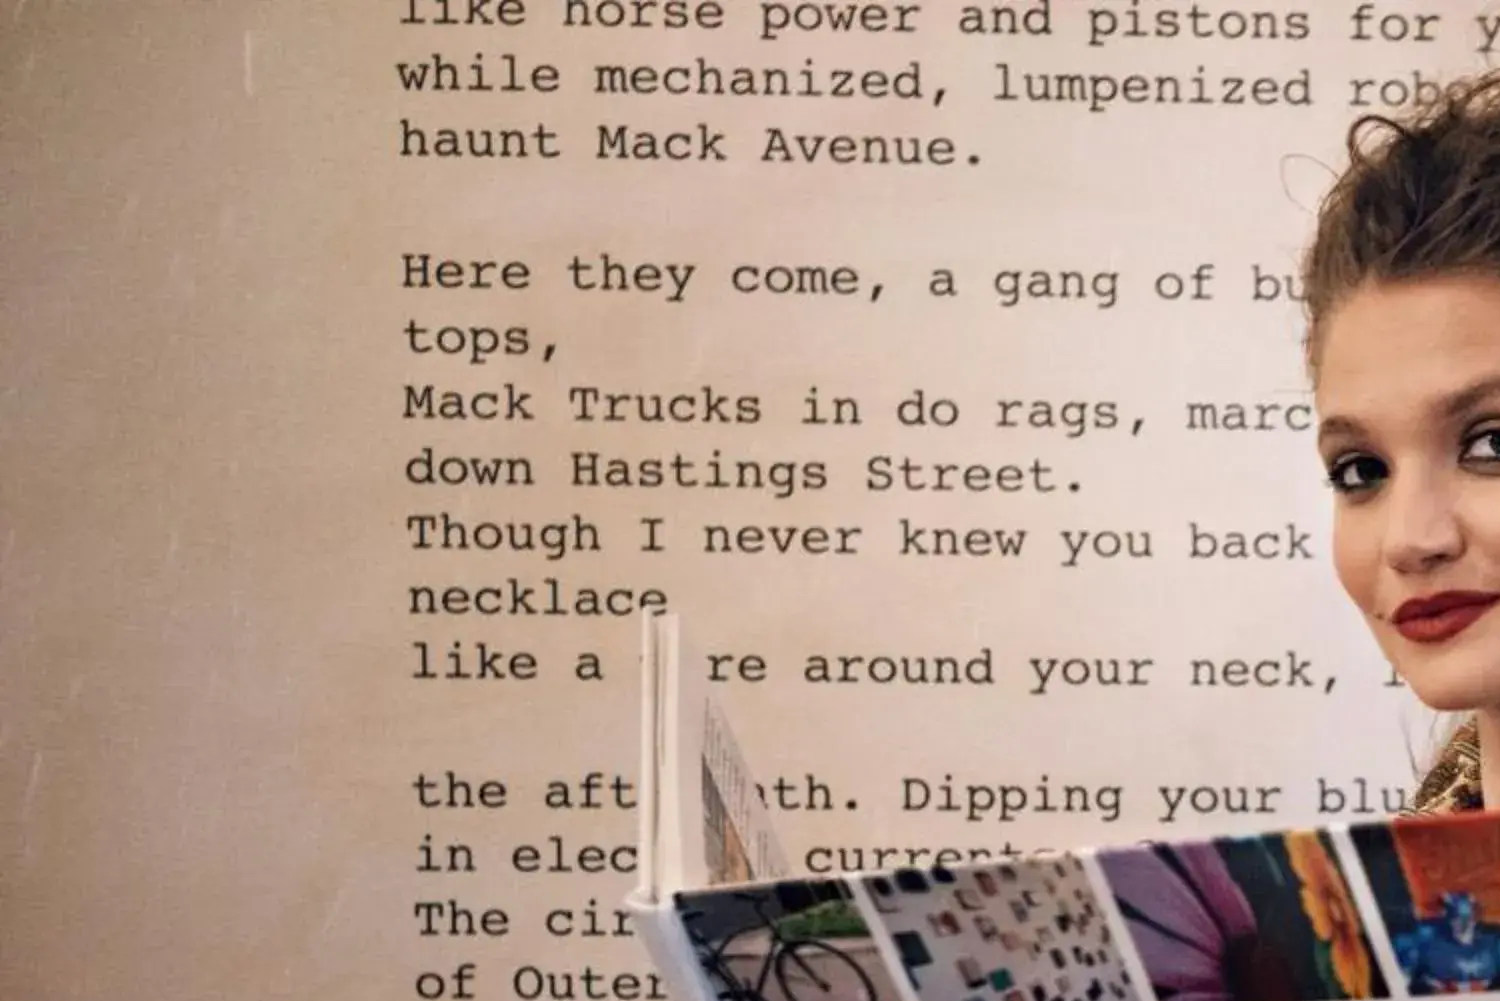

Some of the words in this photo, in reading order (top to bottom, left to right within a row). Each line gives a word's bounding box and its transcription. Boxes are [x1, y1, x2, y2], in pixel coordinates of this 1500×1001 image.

[760, 2, 922, 41] power
[1088, 0, 1310, 47] pistons
[1350, 3, 1441, 42] for
[395, 52, 560, 93] while
[594, 57, 946, 108] mechanized,
[994, 63, 1314, 113] lumpenized
[400, 118, 560, 159] haunt
[596, 123, 727, 162] Mack
[760, 128, 980, 166] Avenue.
[402, 253, 531, 290] Here
[567, 252, 696, 303] they
[731, 265, 884, 303] come,
[929, 269, 958, 297] a
[994, 270, 1120, 309] gang
[1155, 264, 1215, 300] of
[403, 319, 556, 365] tops,
[402, 383, 535, 421] Mack
[569, 385, 762, 424] Trucks
[801, 386, 862, 425] in
[897, 389, 960, 427] do
[996, 400, 1144, 439] rags,
[1186, 403, 1310, 431] marc
[405, 447, 535, 486] down
[570, 449, 827, 499] Hastings
[866, 455, 1080, 493] Street.
[406, 512, 601, 561] Though
[640, 517, 665, 552] I
[704, 525, 862, 555] never
[899, 518, 1028, 557] knew
[1060, 530, 1153, 567] you
[1189, 522, 1313, 560] back
[412, 640, 538, 680] like
[575, 653, 604, 681] a
[804, 648, 995, 685] around
[1029, 658, 1154, 696] your
[1190, 650, 1336, 695] neck,
[412, 770, 507, 809] the
[902, 773, 1124, 823] Dipping
[1158, 786, 1282, 823] your
[416, 833, 477, 872] in
[414, 899, 510, 937] The
[415, 962, 476, 1000] of
